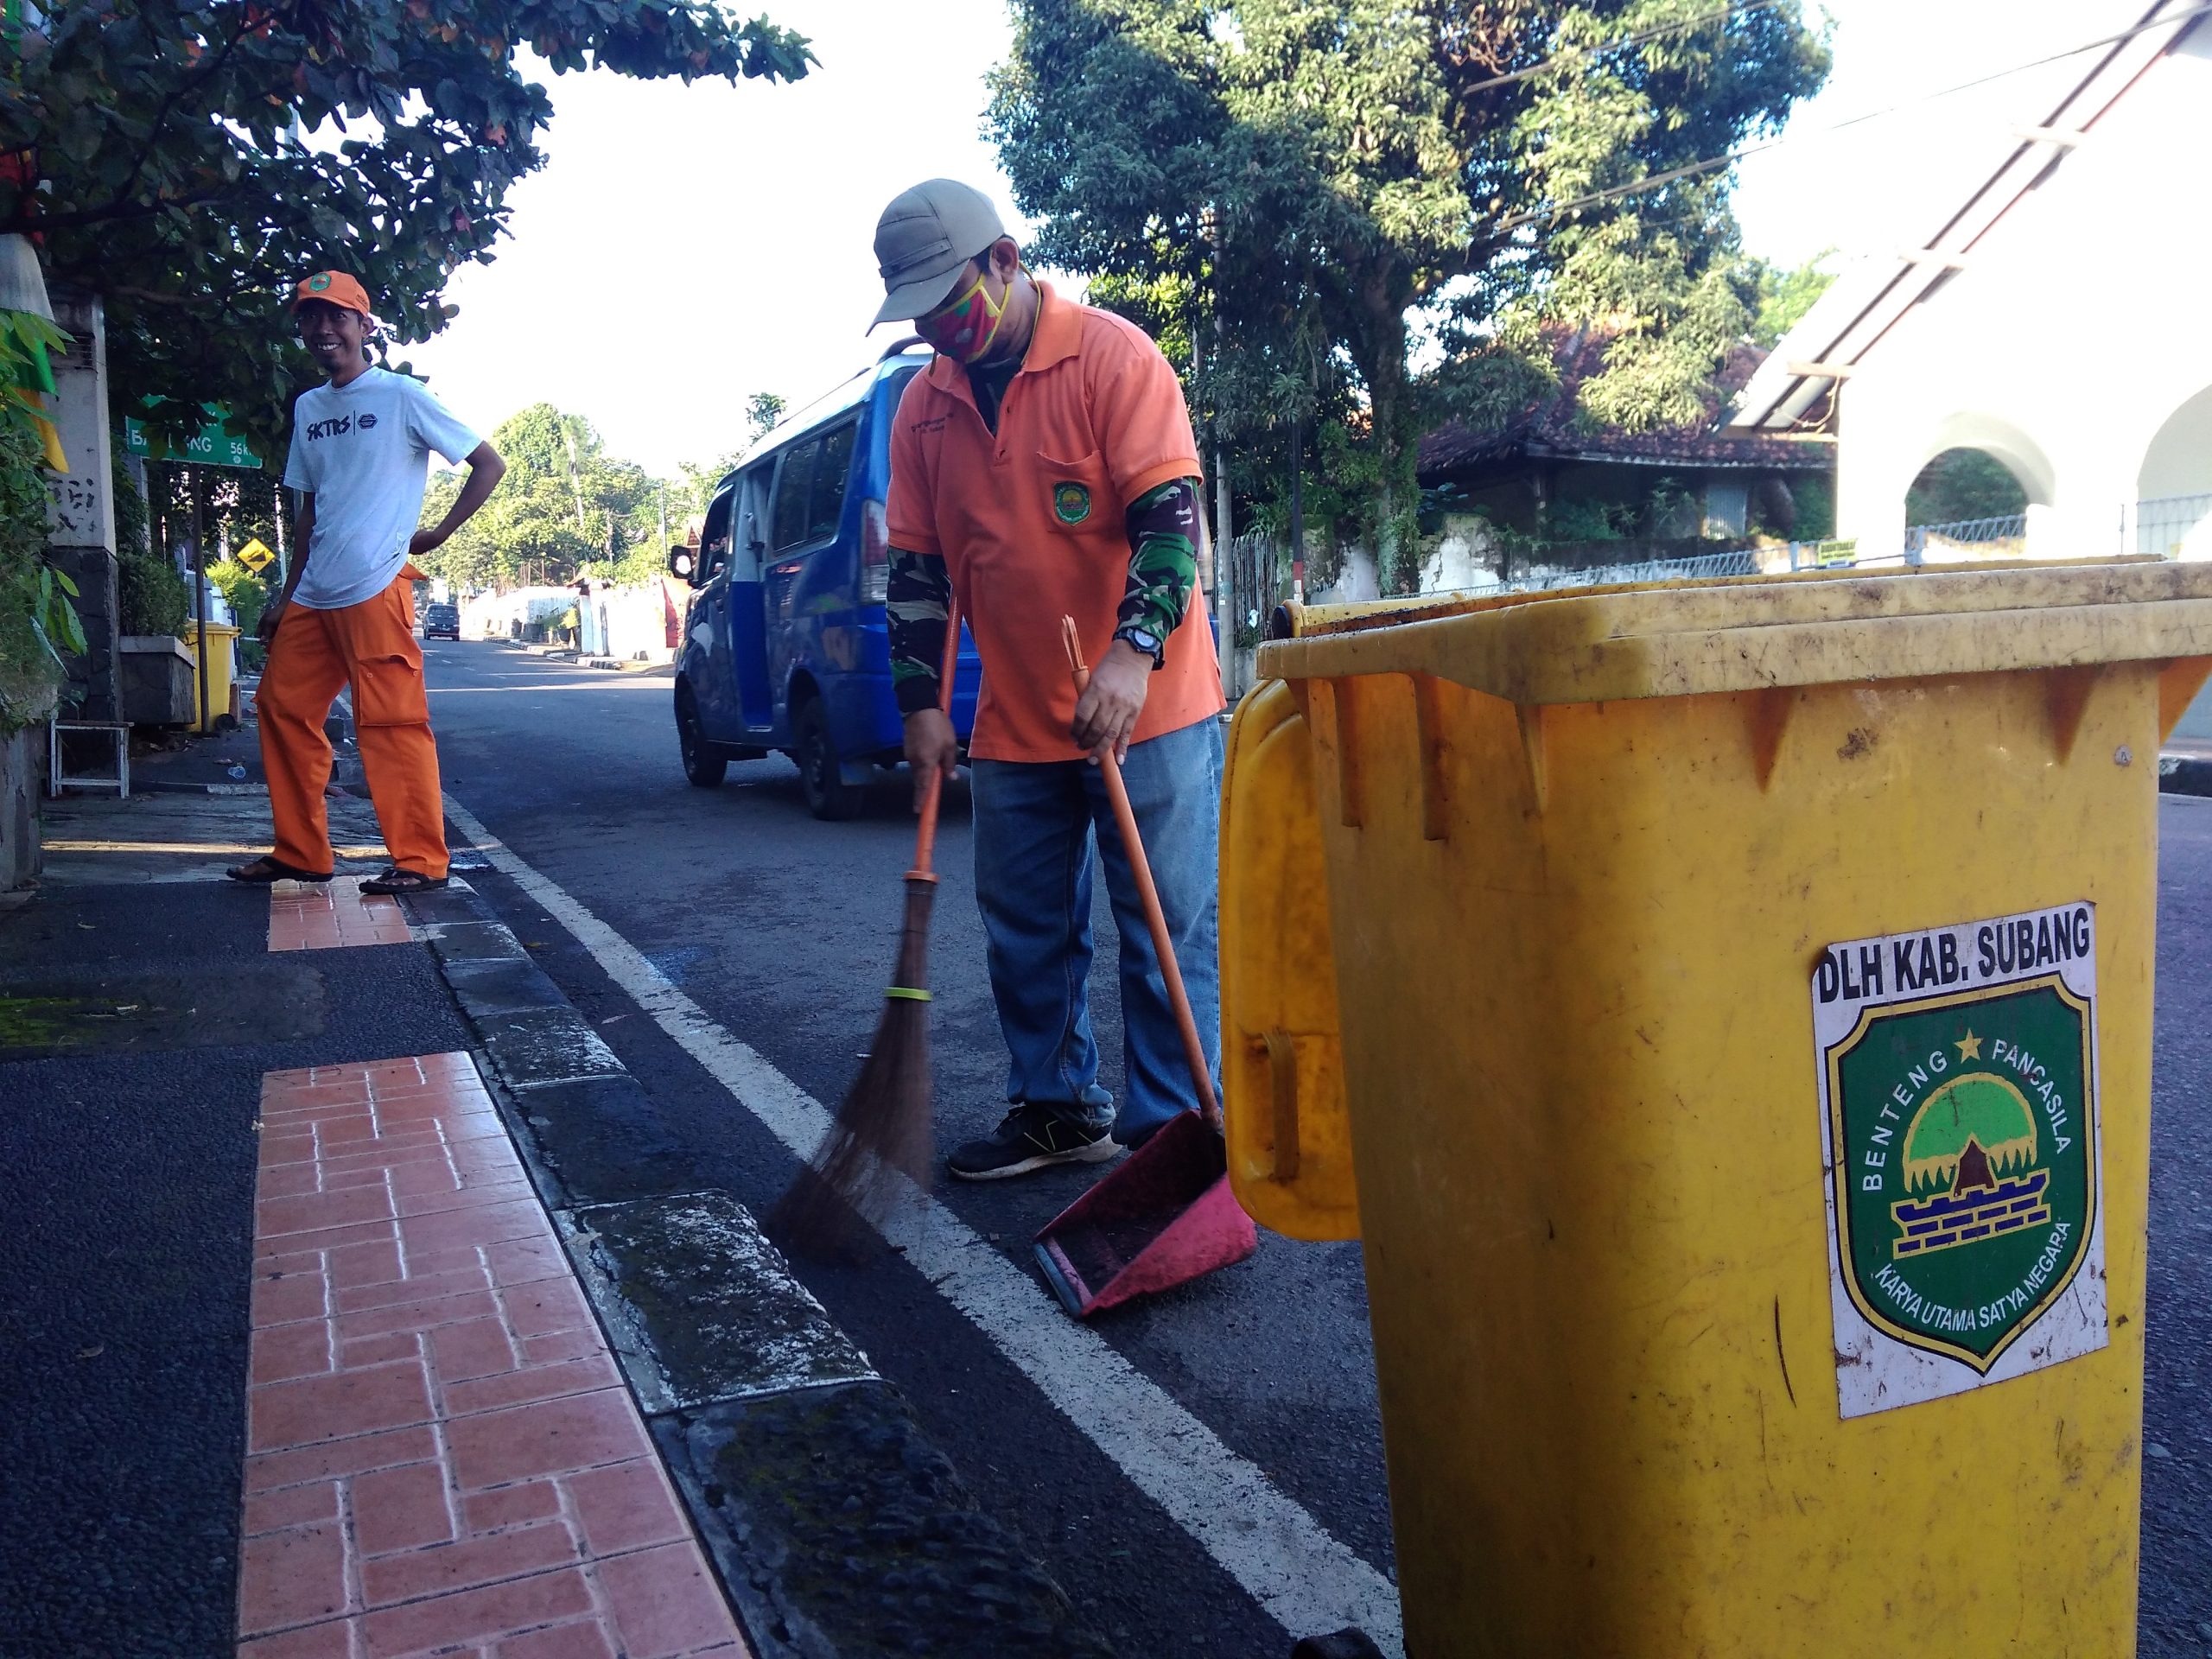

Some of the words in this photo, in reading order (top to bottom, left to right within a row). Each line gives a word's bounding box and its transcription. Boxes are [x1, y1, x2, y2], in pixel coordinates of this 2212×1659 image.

[231, 442, 253, 455] 56k
[307, 416, 351, 442] SKTRS
[1819, 944, 1884, 1004] DLH
[1894, 932, 1969, 992] KAB.
[1978, 908, 2090, 978] SUBANG
[1862, 1050, 1948, 1192] BENTENG
[1992, 1039, 2072, 1155] PANCASILA
[1874, 1262, 1923, 1319] KARYA
[1923, 1301, 1977, 1332] UTAMA
[1979, 1287, 2029, 1329] SATYA
[2024, 1223, 2071, 1295] NEGARA
